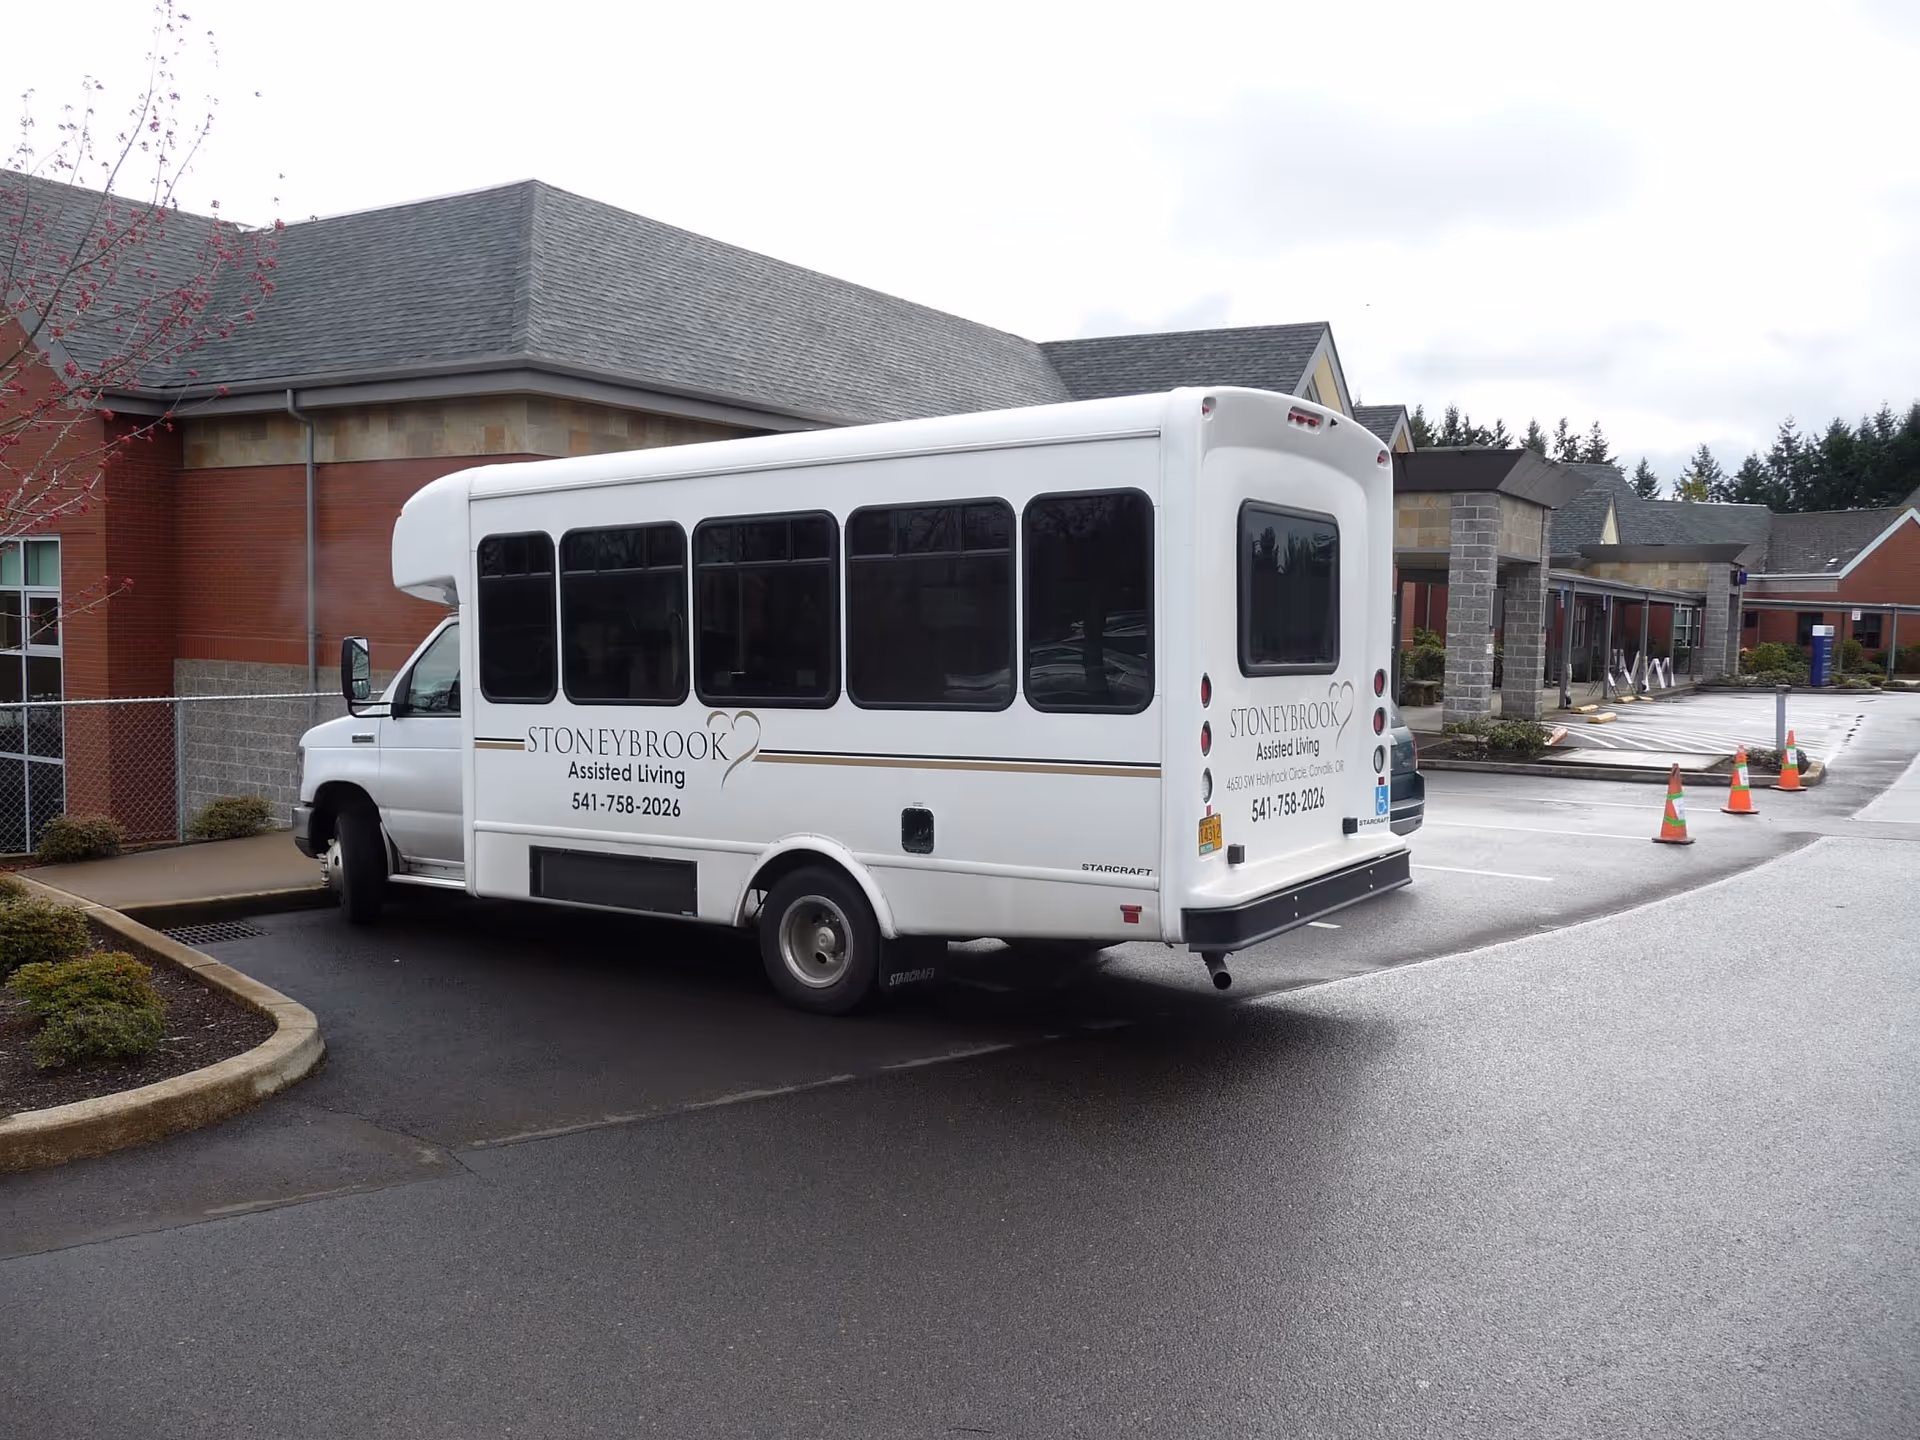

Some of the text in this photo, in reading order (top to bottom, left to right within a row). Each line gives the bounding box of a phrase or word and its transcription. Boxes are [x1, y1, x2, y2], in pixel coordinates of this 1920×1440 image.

[1230, 701, 1340, 738] STONEYBROOK
[527, 726, 731, 761] STONEYBROOK
[1256, 736, 1320, 761] Assisted Living
[568, 761, 686, 789] Assisted Living
[572, 792, 681, 817] 541-758-2026
[1251, 786, 1325, 822] 541-758-2026
[1081, 863, 1153, 876] STARCRAFT
[889, 967, 935, 986] STARCRAFT
